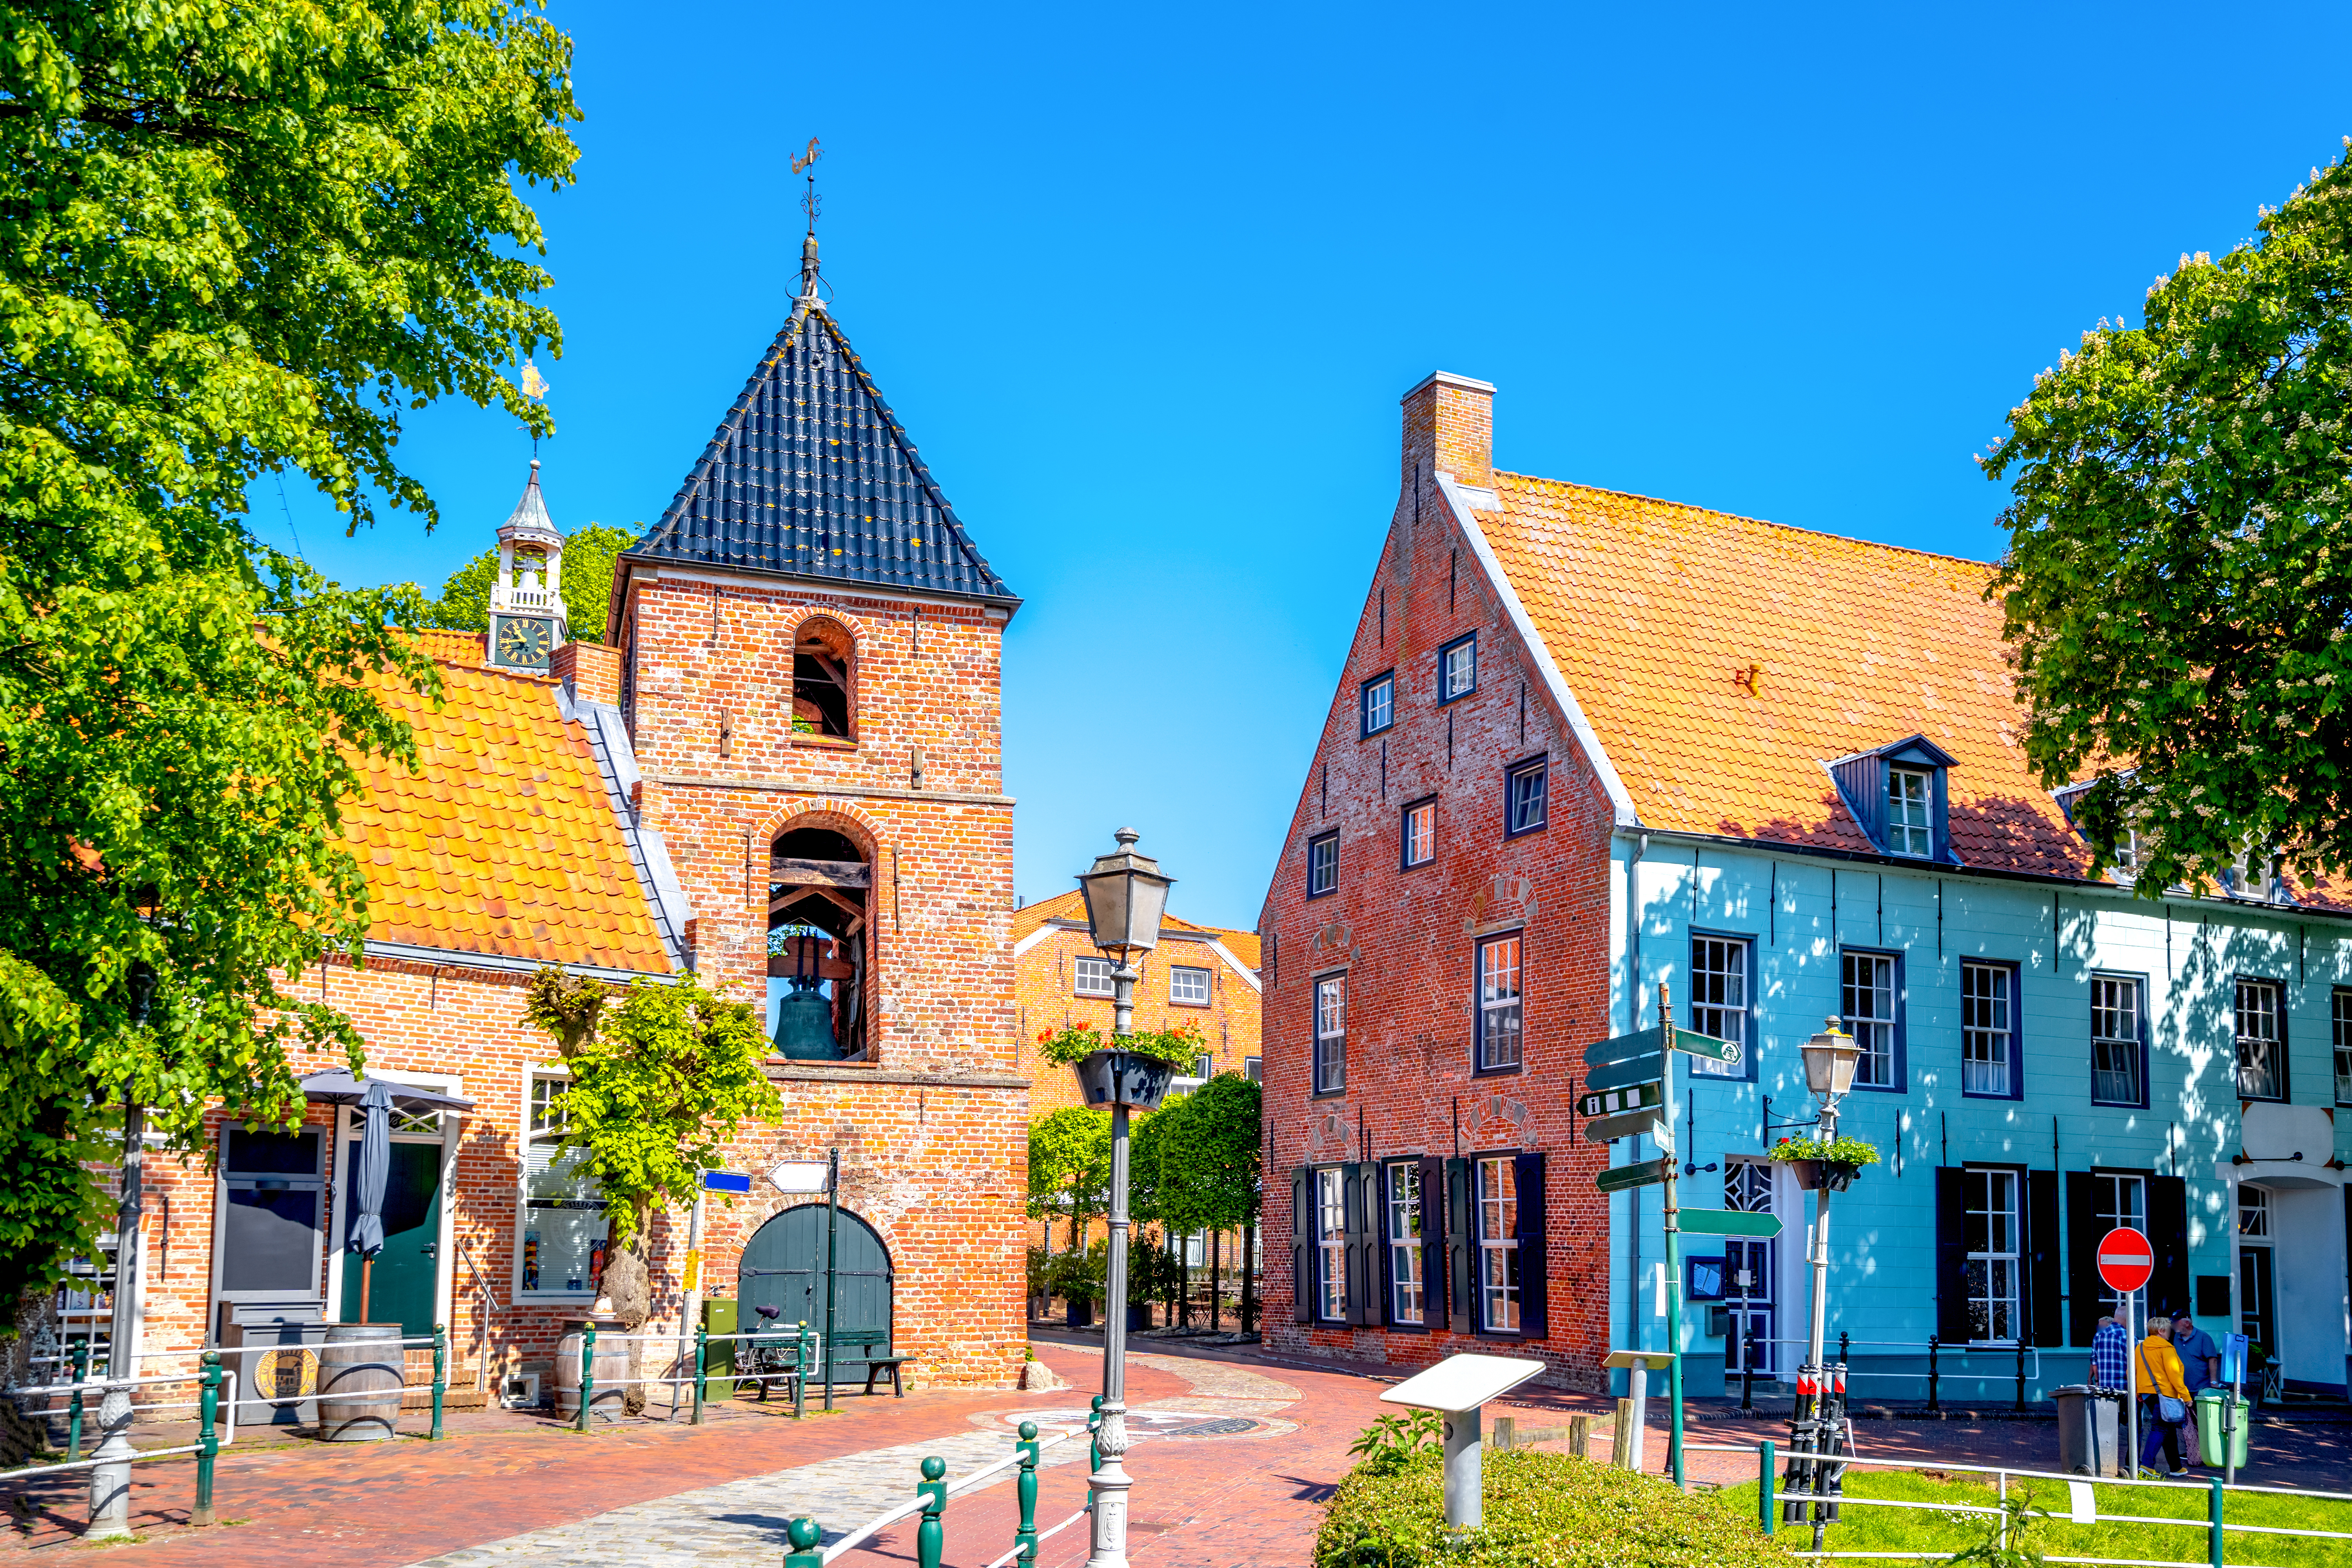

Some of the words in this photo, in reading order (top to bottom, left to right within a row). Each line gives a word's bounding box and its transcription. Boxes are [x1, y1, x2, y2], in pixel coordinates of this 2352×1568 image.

[532, 622, 538, 630] I
[522, 655, 527, 663] VI
[1591, 1098, 1597, 1113] i
[389, 1116, 401, 1125] 18
